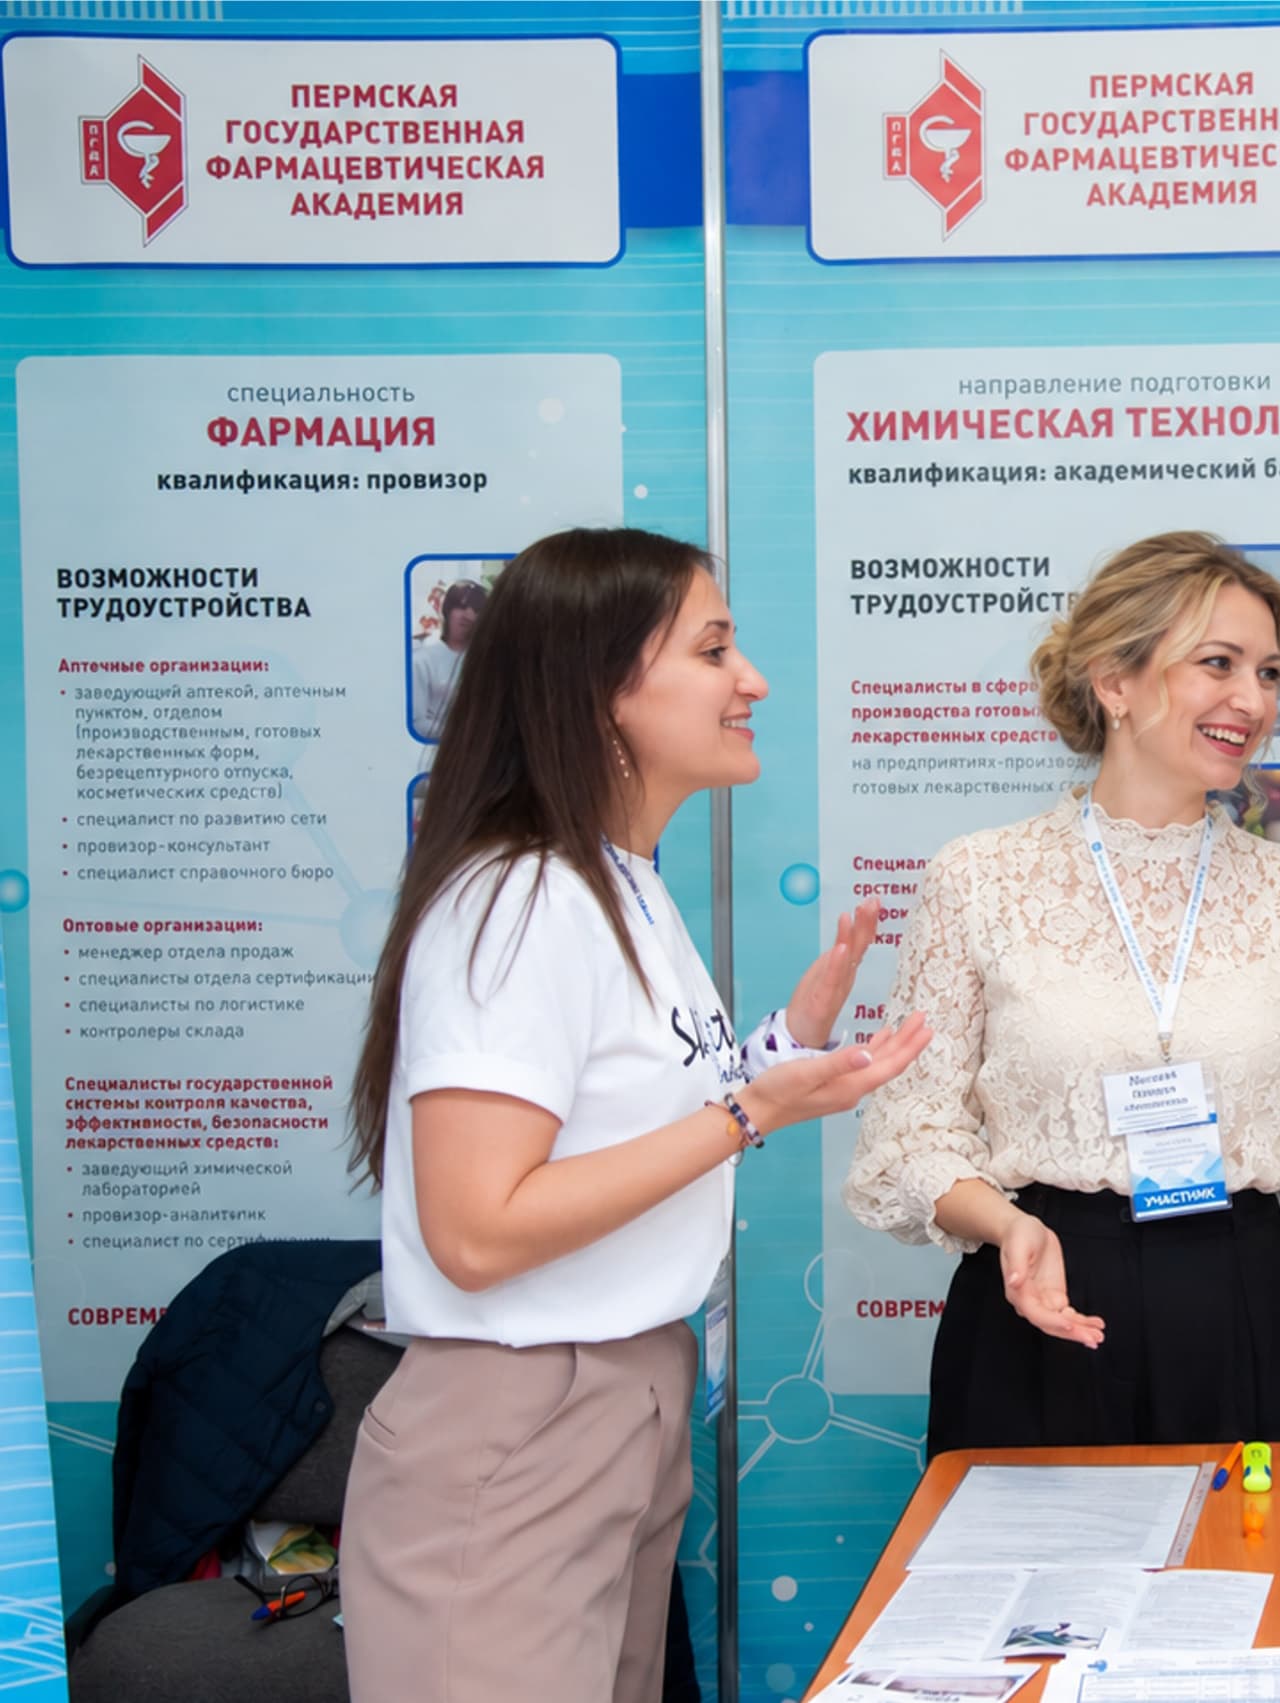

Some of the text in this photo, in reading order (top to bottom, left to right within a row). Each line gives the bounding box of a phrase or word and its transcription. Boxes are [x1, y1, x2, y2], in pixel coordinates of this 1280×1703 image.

[1090, 72, 1253, 98] ПЕРМСКАЯ
[292, 85, 457, 108] ПЕРМСКАЯ
[226, 120, 523, 149] ГОСУДАРСТВЕННАЯ
[206, 156, 544, 184] ФАРМАЦЕВТИЧЕСКАЯ
[1087, 180, 1256, 210] АКАДЕМИЯ
[291, 192, 462, 220] АКАДЕМИЯ
[227, 387, 415, 406] специальность
[959, 376, 1270, 400] направление подготовки
[847, 408, 1113, 441] ХИМИЧЕСКАЯ
[208, 417, 434, 452] ФАРМАЦИЯ
[849, 462, 1045, 487] квалификация:
[1054, 458, 1255, 483] академический
[158, 469, 487, 494] квалификация: провизор
[851, 557, 1049, 579] ВОЗМОЖНОСТИ
[58, 568, 257, 588] ВОЗМОЖНОСТИ
[57, 597, 310, 622] ТРУДОУСТРОЙСТВА
[59, 658, 268, 675] Аптечные организации:
[186, 684, 258, 699] аптекой,
[264, 686, 346, 698] аптечным
[851, 680, 967, 696] Специалисты
[972, 682, 981, 693] в
[153, 707, 222, 721] отделом
[852, 707, 970, 722] производства
[255, 727, 320, 738] готовых
[852, 731, 985, 746] лекарственных
[76, 745, 259, 762] лекарственных форм,
[852, 758, 871, 770] на
[224, 767, 293, 782] отпуска,
[77, 787, 205, 800] косметических
[853, 783, 919, 794] готовых
[924, 782, 1054, 797] лекарственных
[77, 814, 327, 828] специалист по развитию сети
[77, 864, 334, 882] специалист справочного бюро
[853, 857, 929, 874] Специал
[63, 918, 262, 935] Оптовые организации:
[79, 947, 293, 962] менеджер отдела продаж
[79, 974, 189, 987] специалисты
[194, 973, 251, 986] отдела
[79, 1000, 304, 1014] специалисты по логистике
[80, 1026, 244, 1041] контролеры склада
[65, 1076, 332, 1093] Специалисты государственной
[66, 1098, 312, 1112] системы контроля качества,
[212, 1114, 328, 1129] безопасности
[66, 1137, 278, 1151] лекарственных средств:
[194, 1160, 292, 1175] химической
[82, 1181, 200, 1199] лабораторией
[82, 1236, 179, 1250] специалист
[184, 1236, 203, 1247] по
[68, 1308, 166, 1326] СОВРЕМ
[857, 1300, 945, 1318] СОВРЕМ
